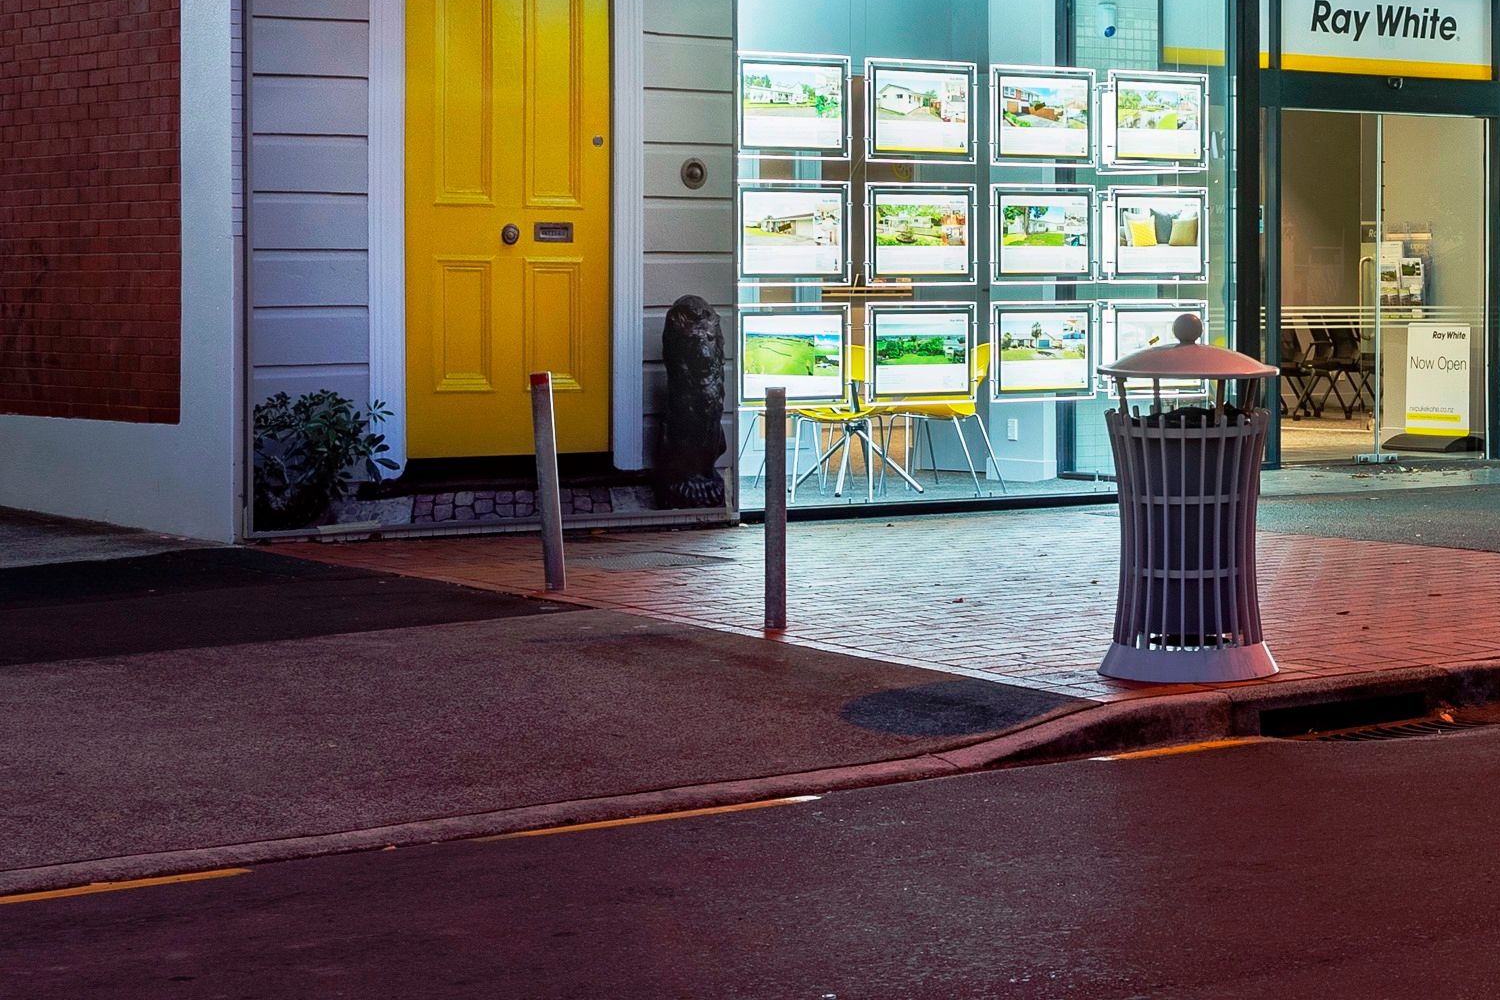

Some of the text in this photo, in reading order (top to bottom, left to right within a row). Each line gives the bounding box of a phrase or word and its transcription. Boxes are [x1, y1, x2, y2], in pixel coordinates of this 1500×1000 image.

[1310, 0, 1457, 42] Ray White
[1432, 330, 1466, 341] Ray White
[1410, 355, 1467, 373] Now Open
